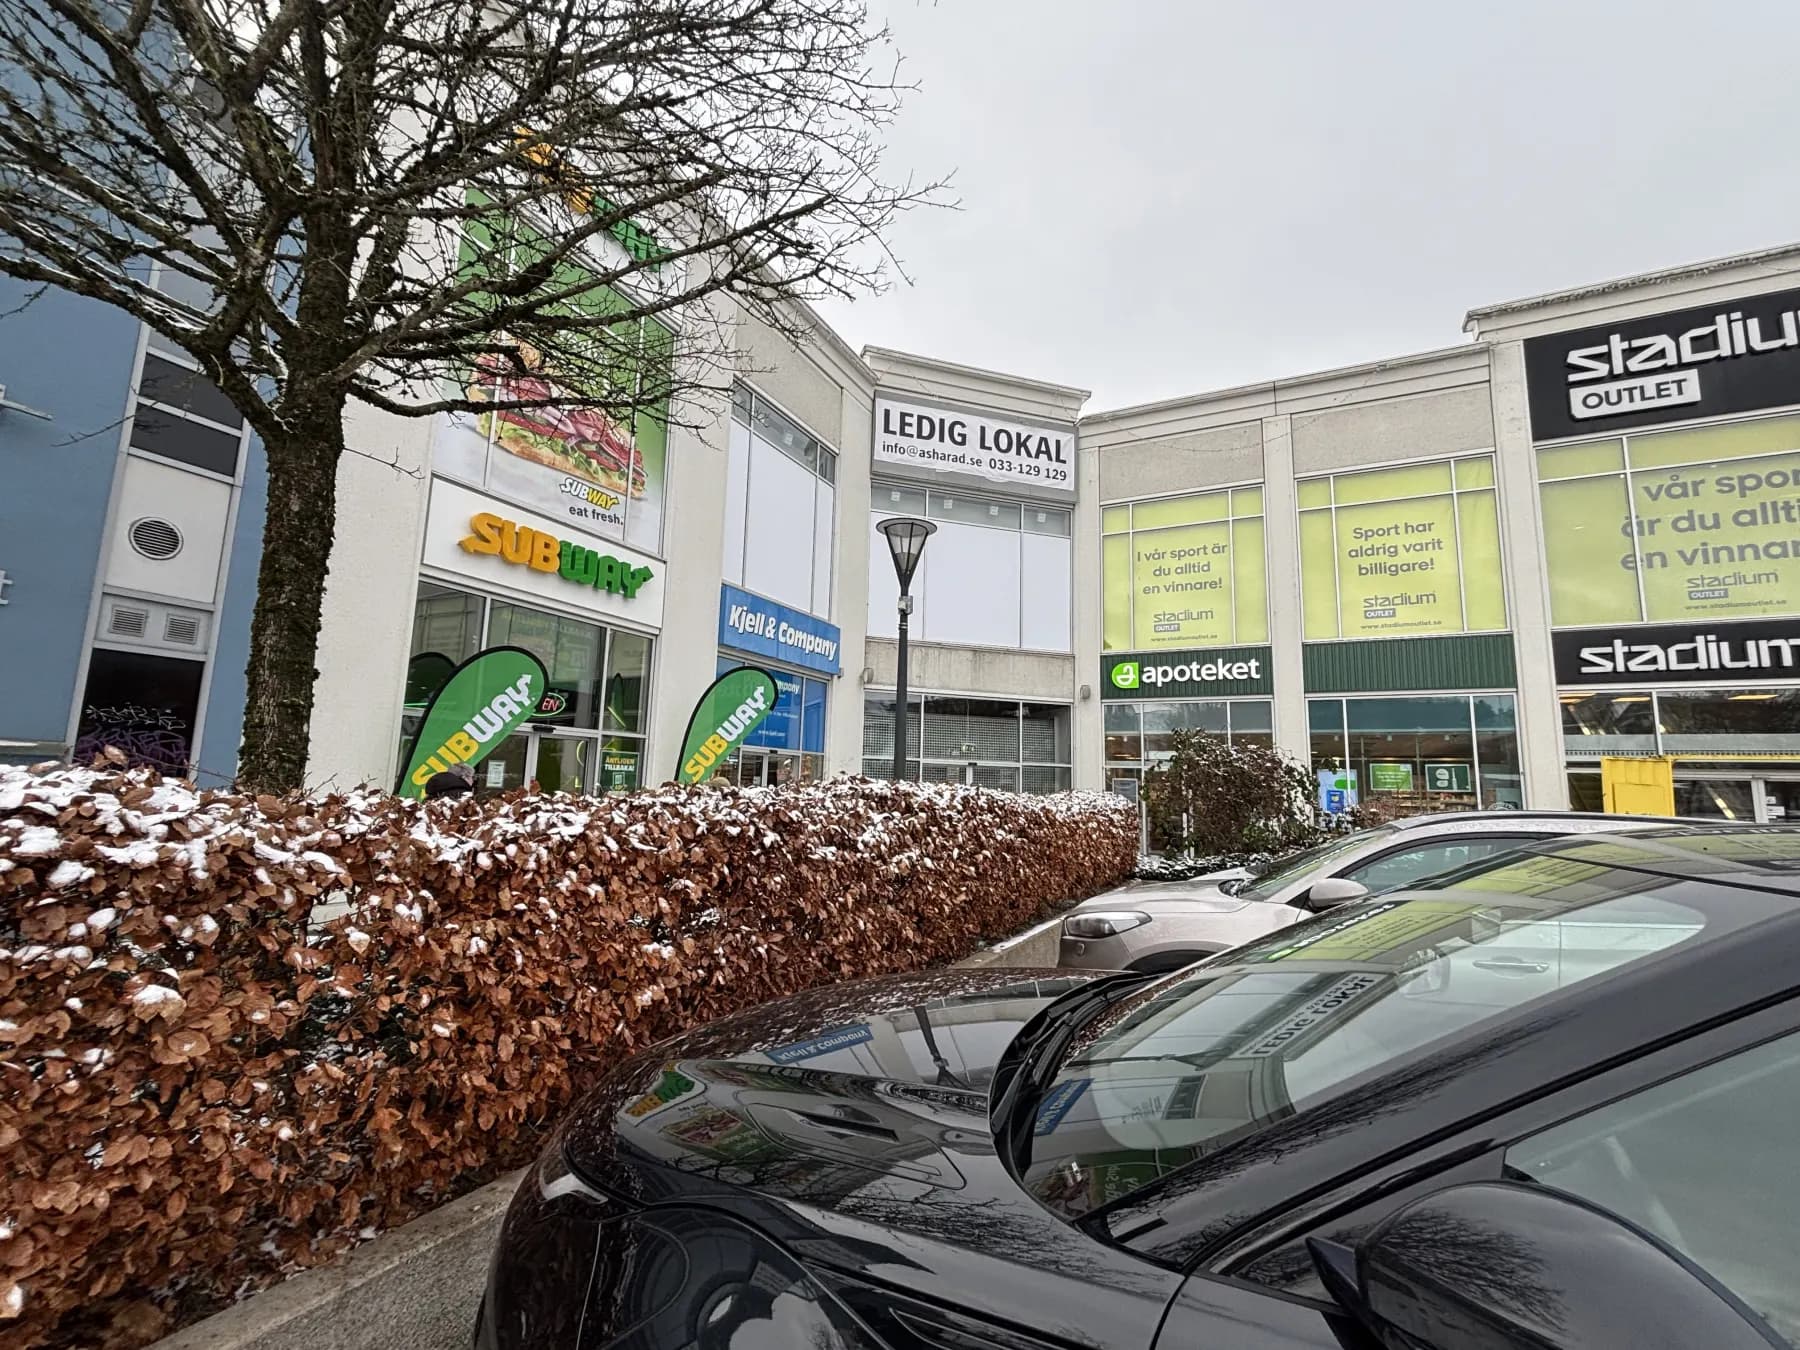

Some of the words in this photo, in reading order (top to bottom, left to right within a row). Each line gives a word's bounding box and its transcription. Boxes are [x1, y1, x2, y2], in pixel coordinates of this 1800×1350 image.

[1566, 311, 1800, 382] stadiu
[1581, 378, 1687, 409] OUTLET
[883, 408, 967, 447] LEDIG
[979, 425, 1067, 464] LOKAL
[882, 441, 983, 466] info@asharad.se
[989, 458, 1040, 476] 033-129
[1045, 468, 1067, 481] 129
[558, 477, 620, 511] SUBWAY
[1642, 474, 1705, 501] vår
[569, 506, 588, 518] eat
[1353, 524, 1400, 541] Sport
[1404, 522, 1435, 534] har
[1621, 515, 1661, 538] är
[1671, 509, 1721, 533] du
[457, 512, 654, 599] SUBWAY
[1144, 548, 1166, 561] vår
[1170, 544, 1208, 561] sport
[1211, 543, 1227, 555] är
[1348, 544, 1398, 558] aldrig
[1403, 539, 1443, 553] varit
[1153, 565, 1171, 577] du
[1174, 562, 1211, 575] alltid
[1358, 557, 1435, 576] billigare!
[1621, 551, 1668, 571] en
[1143, 585, 1160, 595] en
[1164, 577, 1222, 592] vinnare!
[1687, 572, 1779, 588] stadium
[1363, 592, 1436, 608] stadium
[1691, 590, 1725, 598] OUTLET
[1153, 609, 1214, 623] stadium
[729, 604, 766, 636] Kjell
[765, 617, 776, 639] &
[778, 622, 837, 661] Company
[1142, 658, 1261, 687] apoteket
[684, 685, 766, 783] SUBWAY
